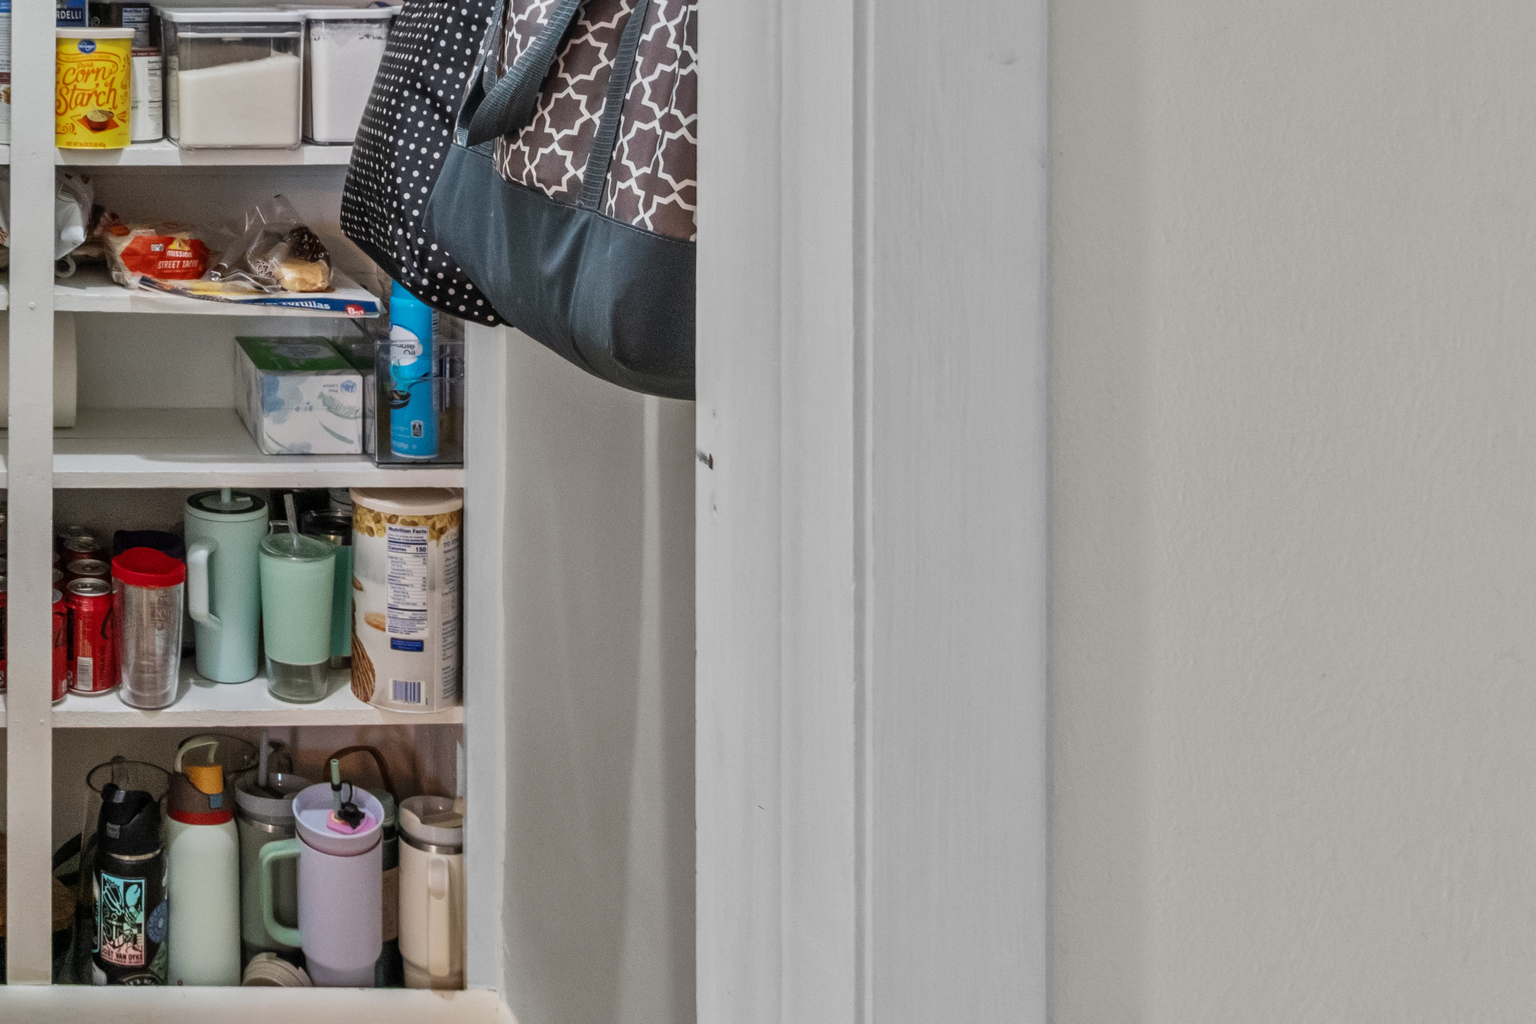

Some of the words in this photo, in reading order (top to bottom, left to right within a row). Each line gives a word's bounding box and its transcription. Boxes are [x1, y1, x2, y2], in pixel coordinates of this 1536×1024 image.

[56, 10, 82, 20] RDELLI
[62, 64, 113, 86] Corn
[56, 77, 117, 117] Starch
[157, 260, 179, 270] STREET
[388, 526, 412, 534] Nutrition
